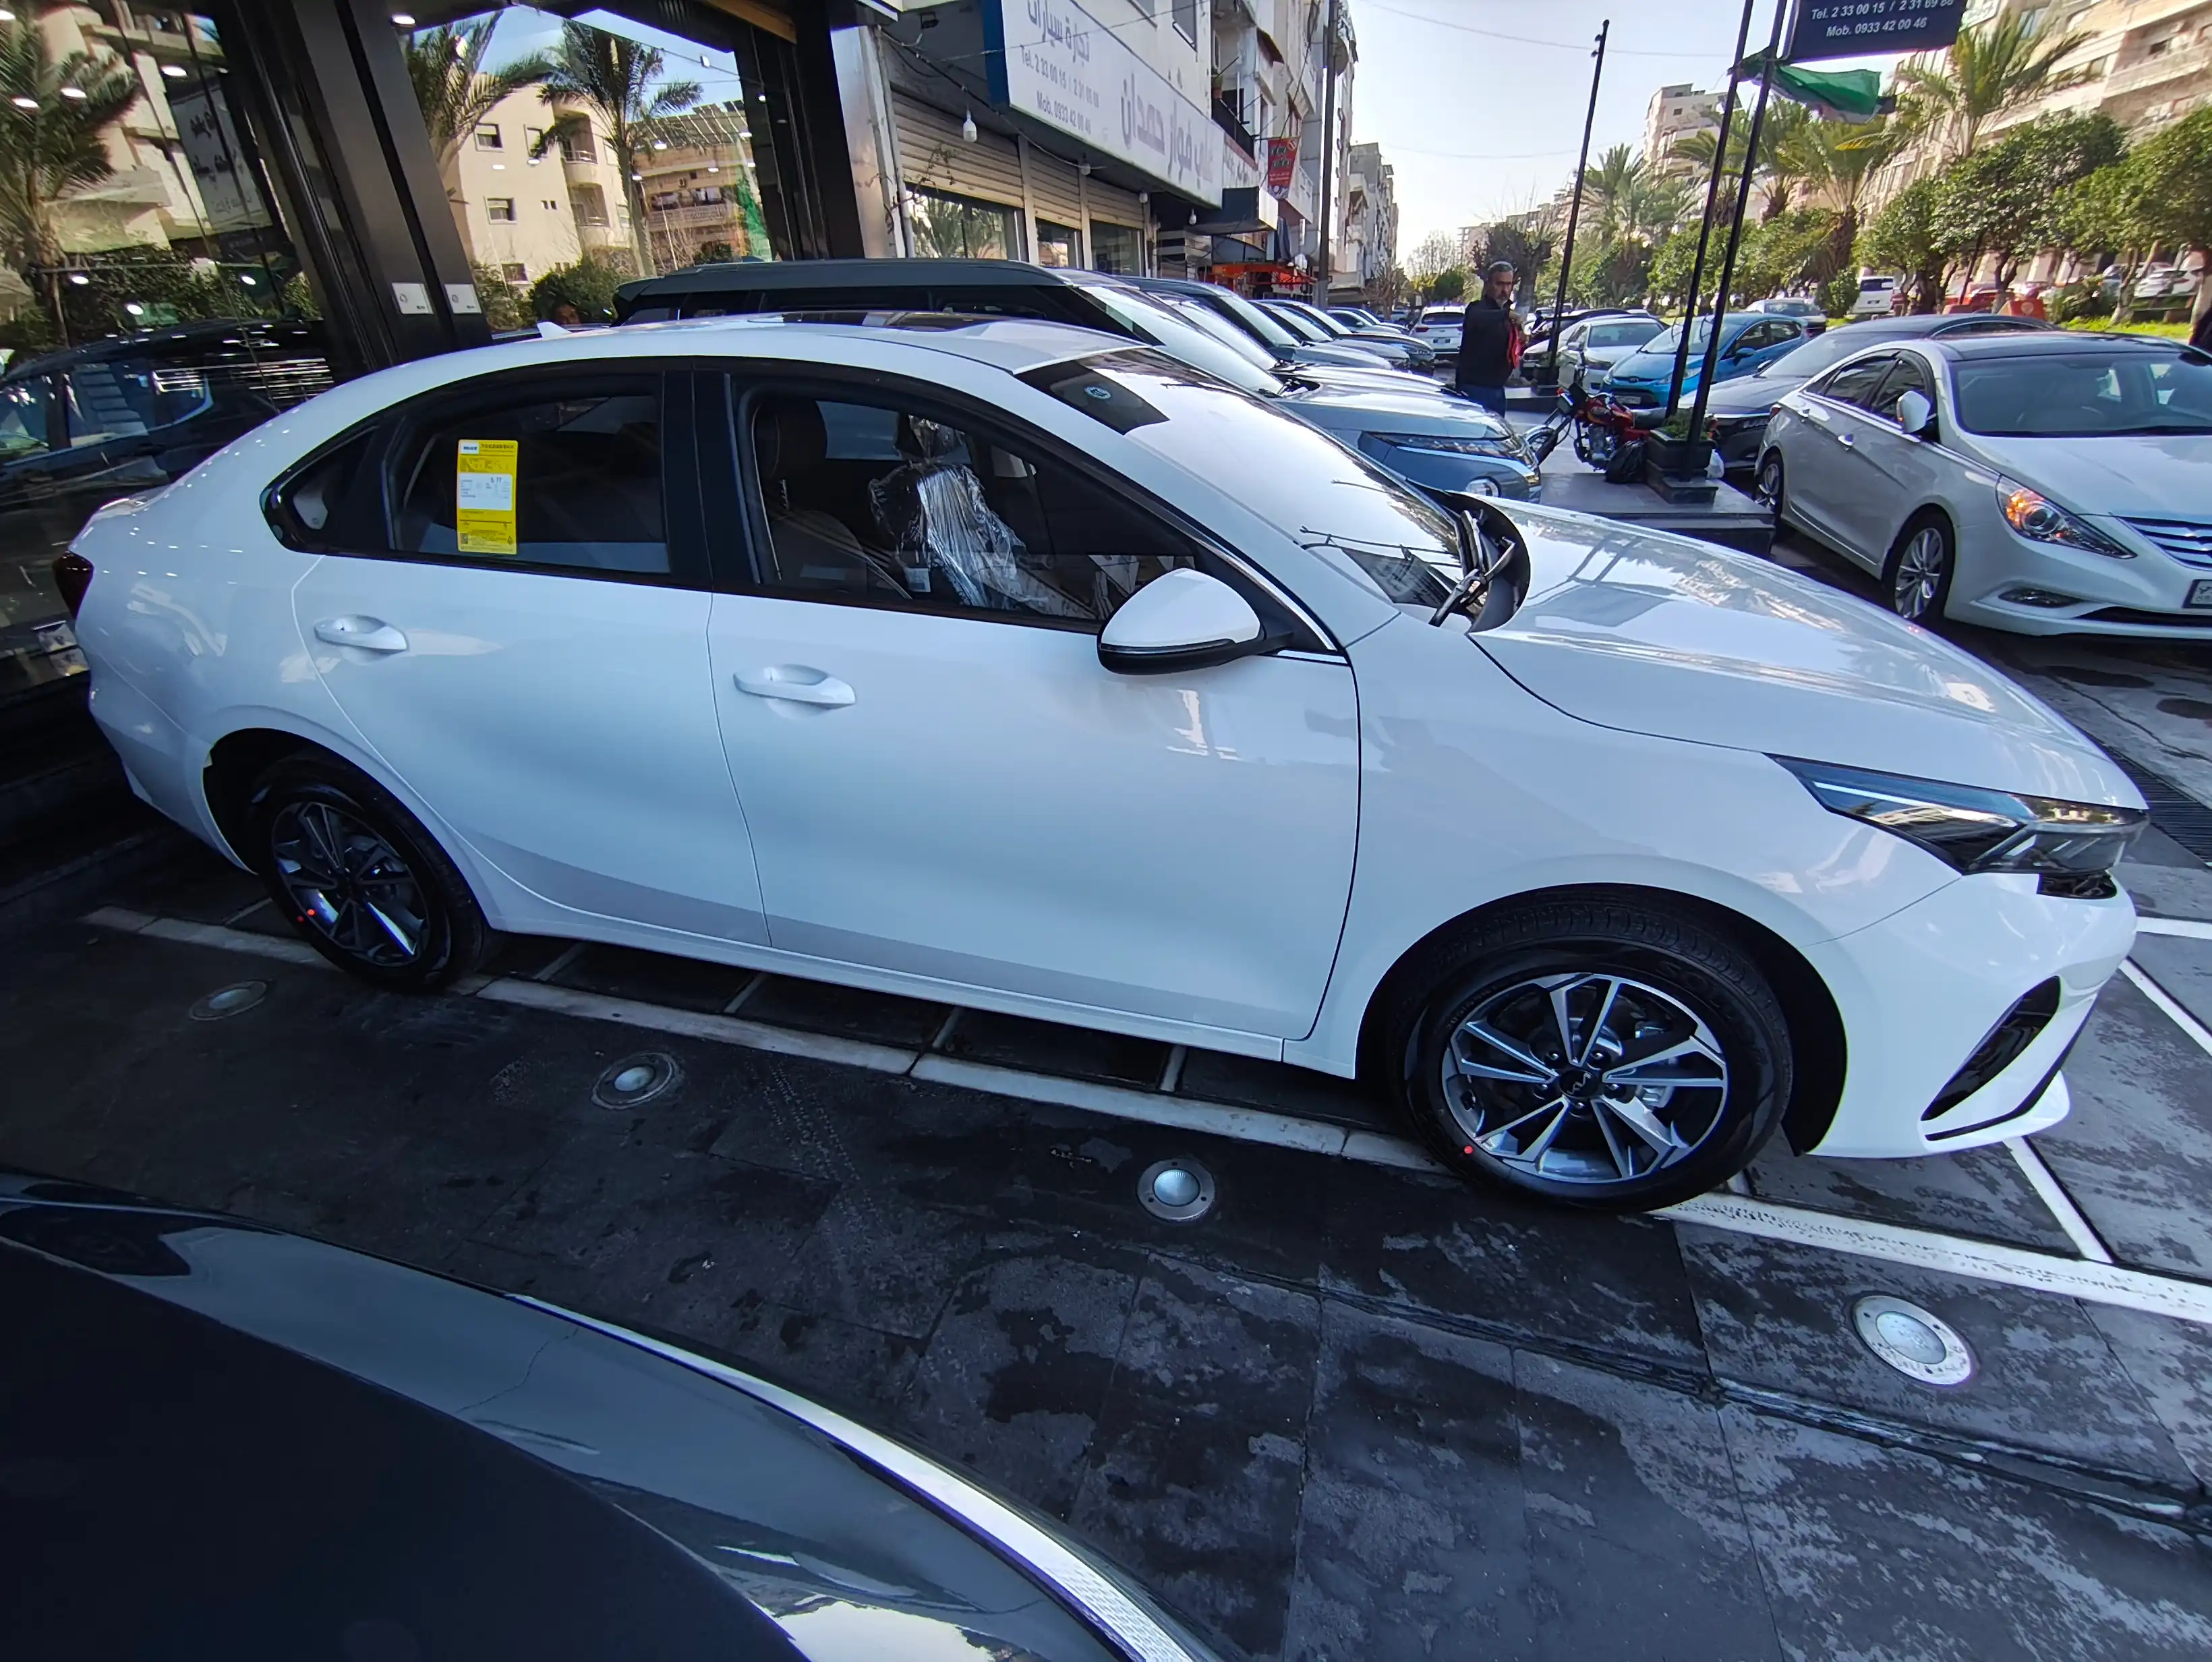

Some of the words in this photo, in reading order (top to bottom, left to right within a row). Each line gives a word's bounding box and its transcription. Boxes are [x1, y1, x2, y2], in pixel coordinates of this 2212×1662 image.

[1811, 8, 1828, 20] Tel.
[1831, 7, 1838, 18] 2
[1840, 5, 1855, 18] 33
[1856, 3, 1870, 16] 00
[1873, 1, 1886, 13] 15
[1889, 1, 1895, 12] /
[1898, 0, 1907, 11] 2
[1909, 0, 1921, 10] 31
[1826, 24, 1852, 37] Mob.
[1855, 22, 1881, 34] 0933
[1882, 20, 1896, 32] 42
[1898, 18, 1912, 30] 00
[1913, 17, 1928, 28] 46
[1066, 16, 1089, 67] تجارة
[1020, 45, 1033, 69] Tel.
[1035, 53, 1040, 74] 2
[1041, 57, 1049, 78] 33
[1049, 63, 1057, 84] 00
[1059, 68, 1067, 90] 15
[1073, 78, 1078, 96] 2
[1037, 90, 1053, 117] Mob.
[1054, 100, 1068, 123] 0933
[1070, 108, 1076, 127] 42
[1077, 112, 1084, 132] 00
[1121, 72, 1165, 156] حمدان
[1167, 100, 1192, 183] فواز
